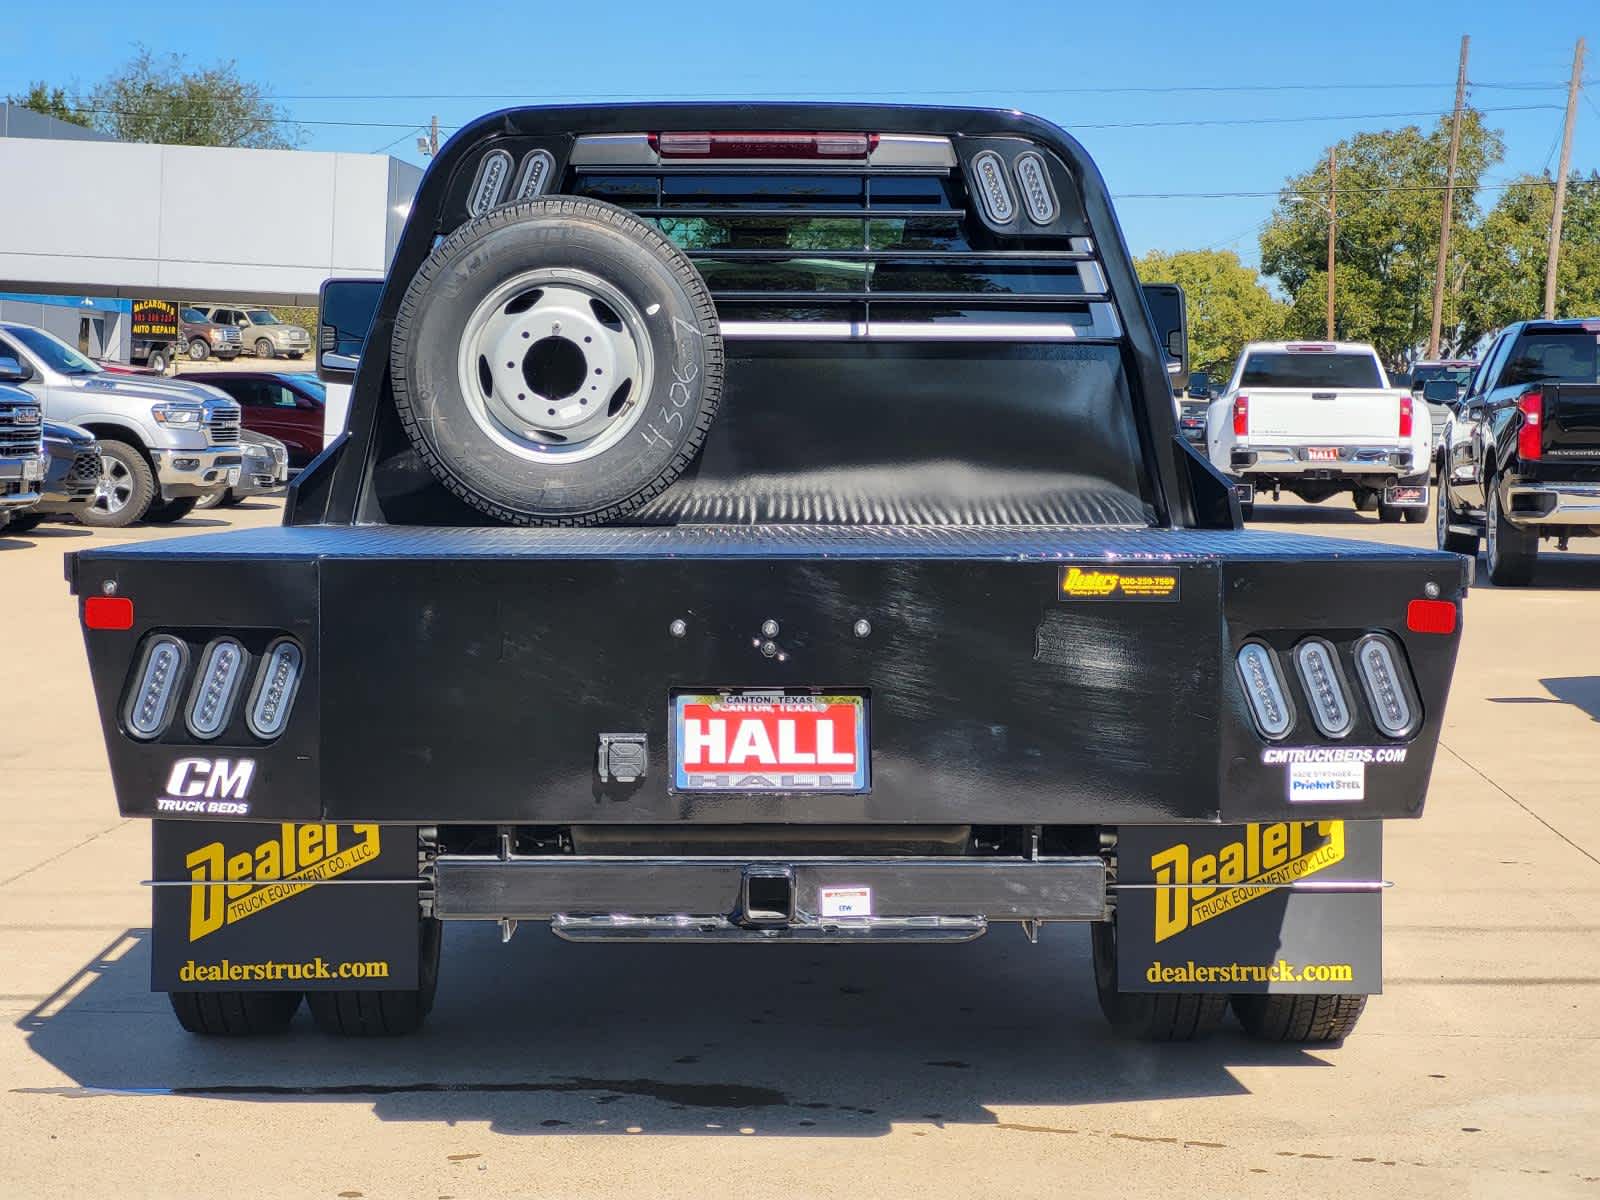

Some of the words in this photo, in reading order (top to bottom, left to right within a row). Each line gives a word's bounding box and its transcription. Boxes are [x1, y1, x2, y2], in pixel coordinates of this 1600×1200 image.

[133, 324, 149, 334] AUTO
[151, 325, 176, 334] REPAIR
[1308, 450, 1336, 460] HALL
[726, 696, 774, 704] CANTON,
[779, 696, 813, 704] TEXAS
[685, 719, 854, 764] HALL
[1263, 748, 1408, 763] CMTRUCKBEDS.COM
[166, 757, 256, 799] CM
[157, 799, 205, 813] TRUCK
[208, 801, 249, 814] BEDS
[230, 890, 267, 918] TRUCK
[268, 864, 327, 901] EQUIPMENT
[1195, 895, 1231, 921] TRUCK
[1232, 868, 1292, 905] EQUIPMENT
[179, 958, 390, 982] dealerstruck.com
[1146, 960, 1352, 983] dealerstruck.com
